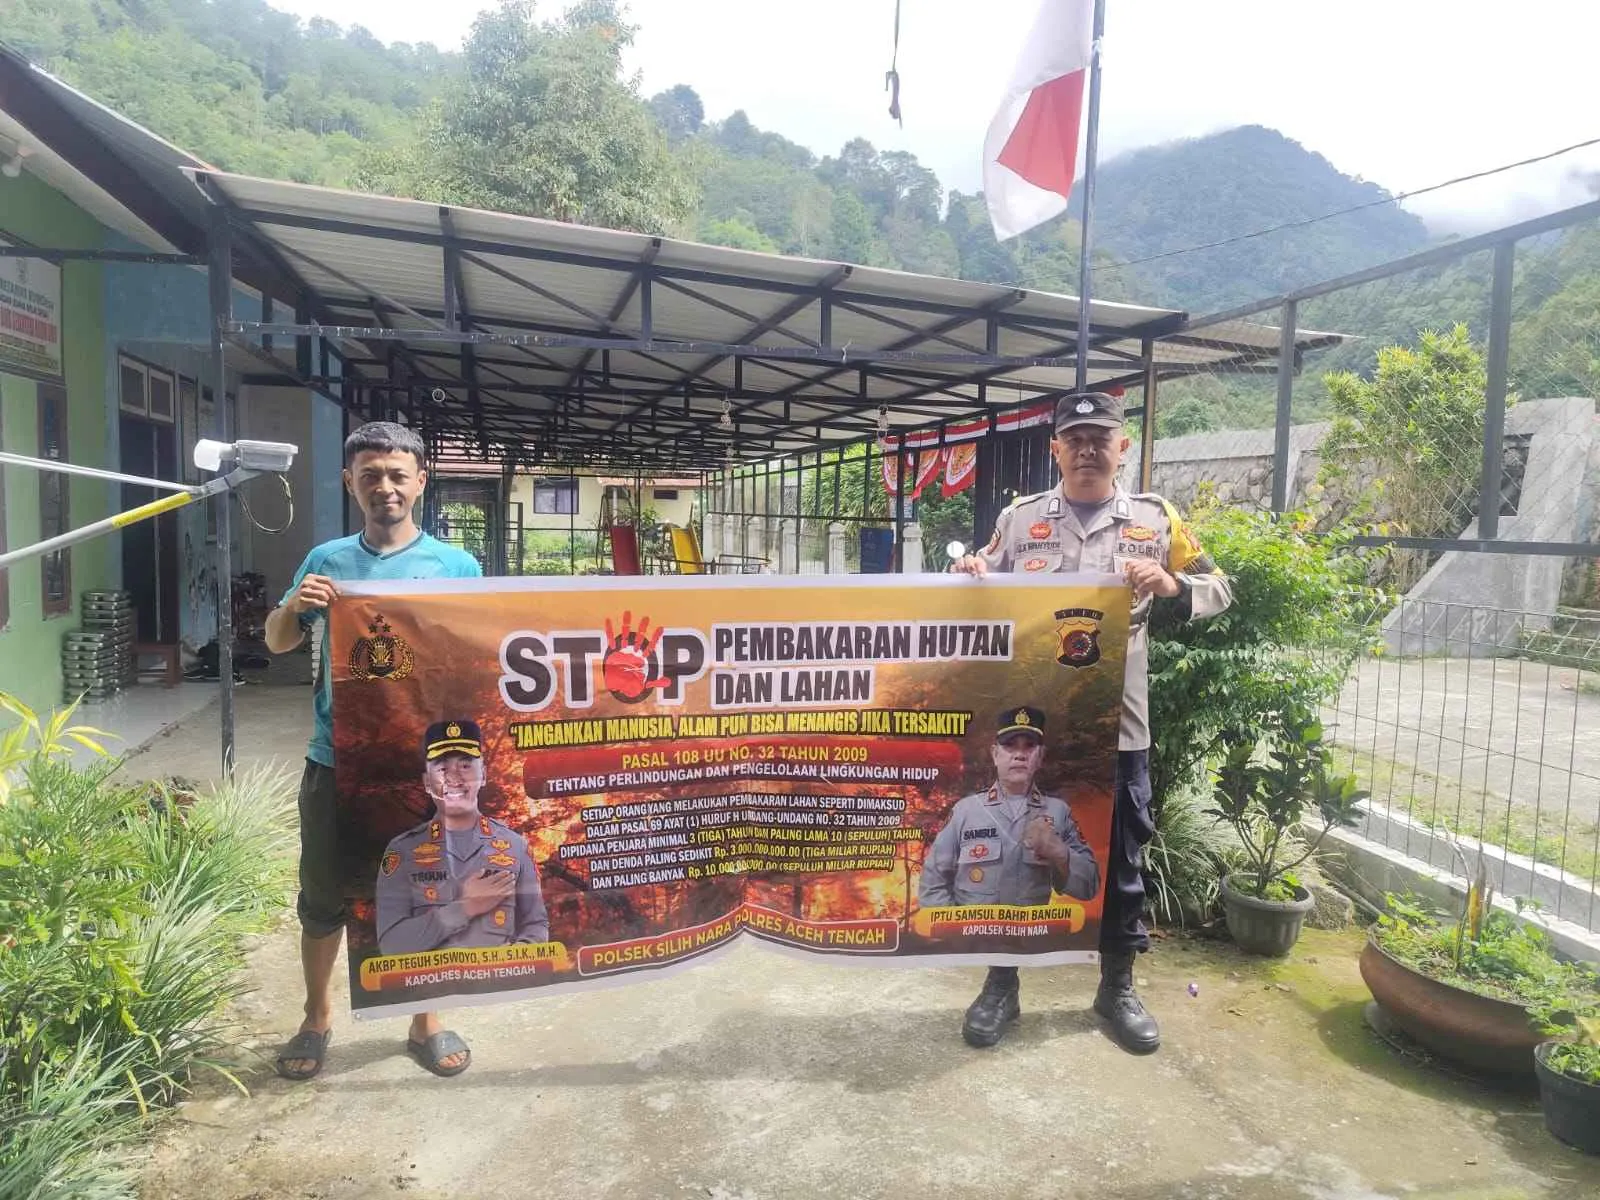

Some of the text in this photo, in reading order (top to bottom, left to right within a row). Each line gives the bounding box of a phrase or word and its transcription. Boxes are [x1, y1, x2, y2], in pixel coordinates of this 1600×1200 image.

[715, 623, 1011, 662] PEMBAKARAN HUTAN
[501, 630, 706, 706] STOP
[715, 669, 871, 705] DAN LAHAN
[606, 716, 677, 741] MANUSIA,
[678, 716, 717, 737] ALAM
[720, 715, 748, 736] PUN
[751, 713, 784, 734] BISA
[787, 711, 858, 733] MENANGIS
[860, 711, 890, 733] JIKA
[622, 747, 868, 769] PASAL 108 UU NO. 32 TAHUN 2009
[548, 763, 939, 793] TENTANG PERLINDUNGAN DAN PENGELOLAAN LINGKUNGAN HIDUP
[582, 793, 905, 822] SETIAP ORANG YANG MELAKUKAN PEMBAKARAN LAHAN SEPERTI DIMAKSUD
[587, 824, 619, 839] DALAM
[621, 821, 649, 835] PASAL
[650, 820, 663, 832] 69
[663, 817, 685, 830] AYAT
[686, 816, 699, 830] (1)
[701, 811, 731, 826] HURUF
[732, 811, 739, 822] H
[815, 813, 831, 825] NO.
[834, 814, 845, 826] 32
[846, 814, 876, 826] TAHUN
[877, 816, 900, 826] 2009
[560, 843, 605, 859] DIPIDANA
[607, 840, 647, 854] PENJARA
[649, 835, 689, 849] MINIMAL
[689, 832, 696, 843] 3
[697, 830, 725, 844] (TIGA)
[726, 826, 754, 840] TAHUN
[754, 827, 769, 839] DAN
[770, 829, 802, 841] PALING
[804, 830, 829, 842] LAMA
[831, 830, 842, 841] 10
[844, 830, 891, 843] (SEPULUH)
[590, 860, 611, 873] DAN
[612, 856, 643, 869] DENDA
[645, 852, 677, 866] PALING
[678, 847, 713, 862] SEDIKIT
[714, 845, 729, 859] Rp.
[802, 846, 826, 859] (TIGA
[827, 845, 858, 857] MILIAR
[860, 844, 896, 857] RUPIAH)
[592, 877, 612, 889] DAN
[614, 872, 648, 887] PALING
[649, 868, 685, 883] BANYAK
[688, 865, 703, 880] Rp.
[779, 861, 823, 872] (SEPULUH
[825, 860, 856, 871] MILIAR
[856, 859, 894, 872] RUPIAH)
[930, 907, 1072, 923] IPTU SAMSUL BAHRI BANGUN
[593, 910, 886, 967] POLSEK SILIH NARA POLRES ACEH TENGAH
[962, 924, 1049, 936] KAPOLSEK SILIH NARA
[368, 958, 396, 974] AKBP
[399, 955, 431, 970] TEGUH
[405, 965, 536, 987] KAPOLRES ACEH TENGAH
